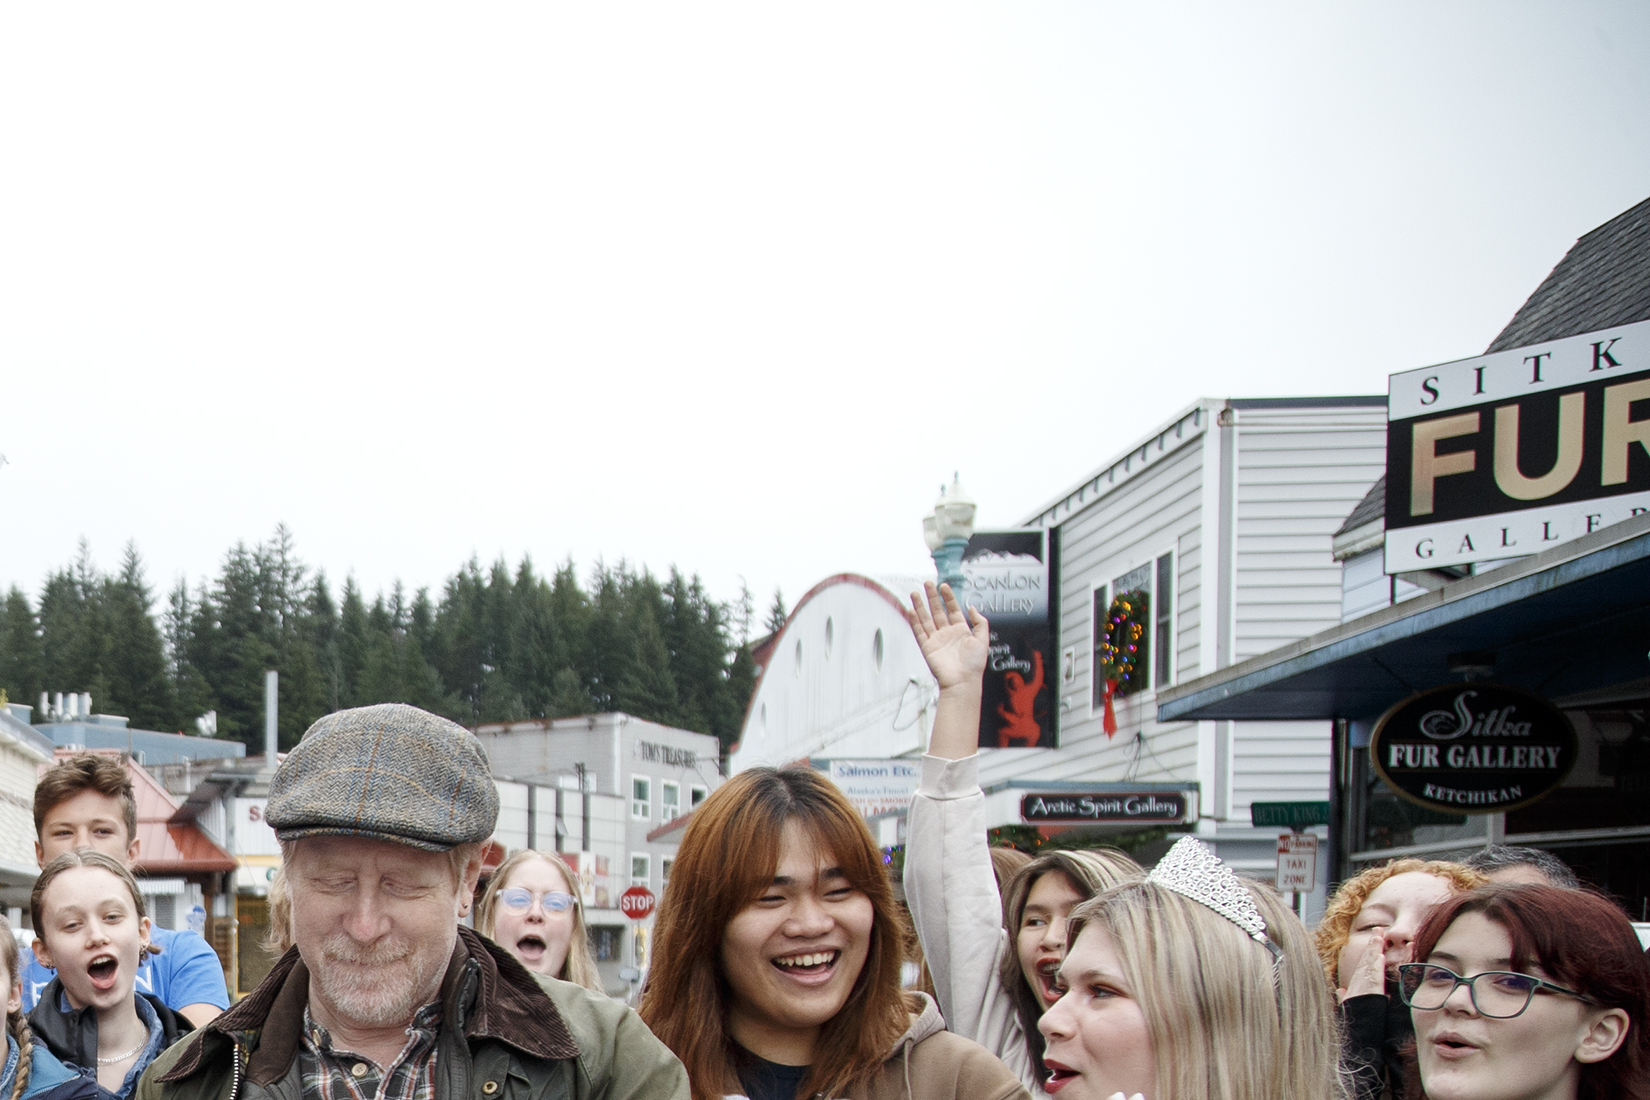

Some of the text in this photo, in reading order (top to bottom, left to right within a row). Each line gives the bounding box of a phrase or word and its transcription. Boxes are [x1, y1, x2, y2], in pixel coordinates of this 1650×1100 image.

[1420, 337, 1623, 406] SITK
[1410, 378, 1650, 517] FUR
[1415, 508, 1649, 559] GALLE
[988, 644, 1011, 658] pirit
[1419, 690, 1533, 740] Sitka
[1389, 744, 1562, 769] FUR GALLERY
[838, 765, 889, 778] Salmon
[1422, 782, 1523, 805] KETCHIKAN
[1030, 796, 1178, 818] Arctic Spirit Gallery
[1286, 860, 1307, 869] TAXI
[1284, 875, 1306, 885] ZONE
[623, 895, 655, 911] STOP
